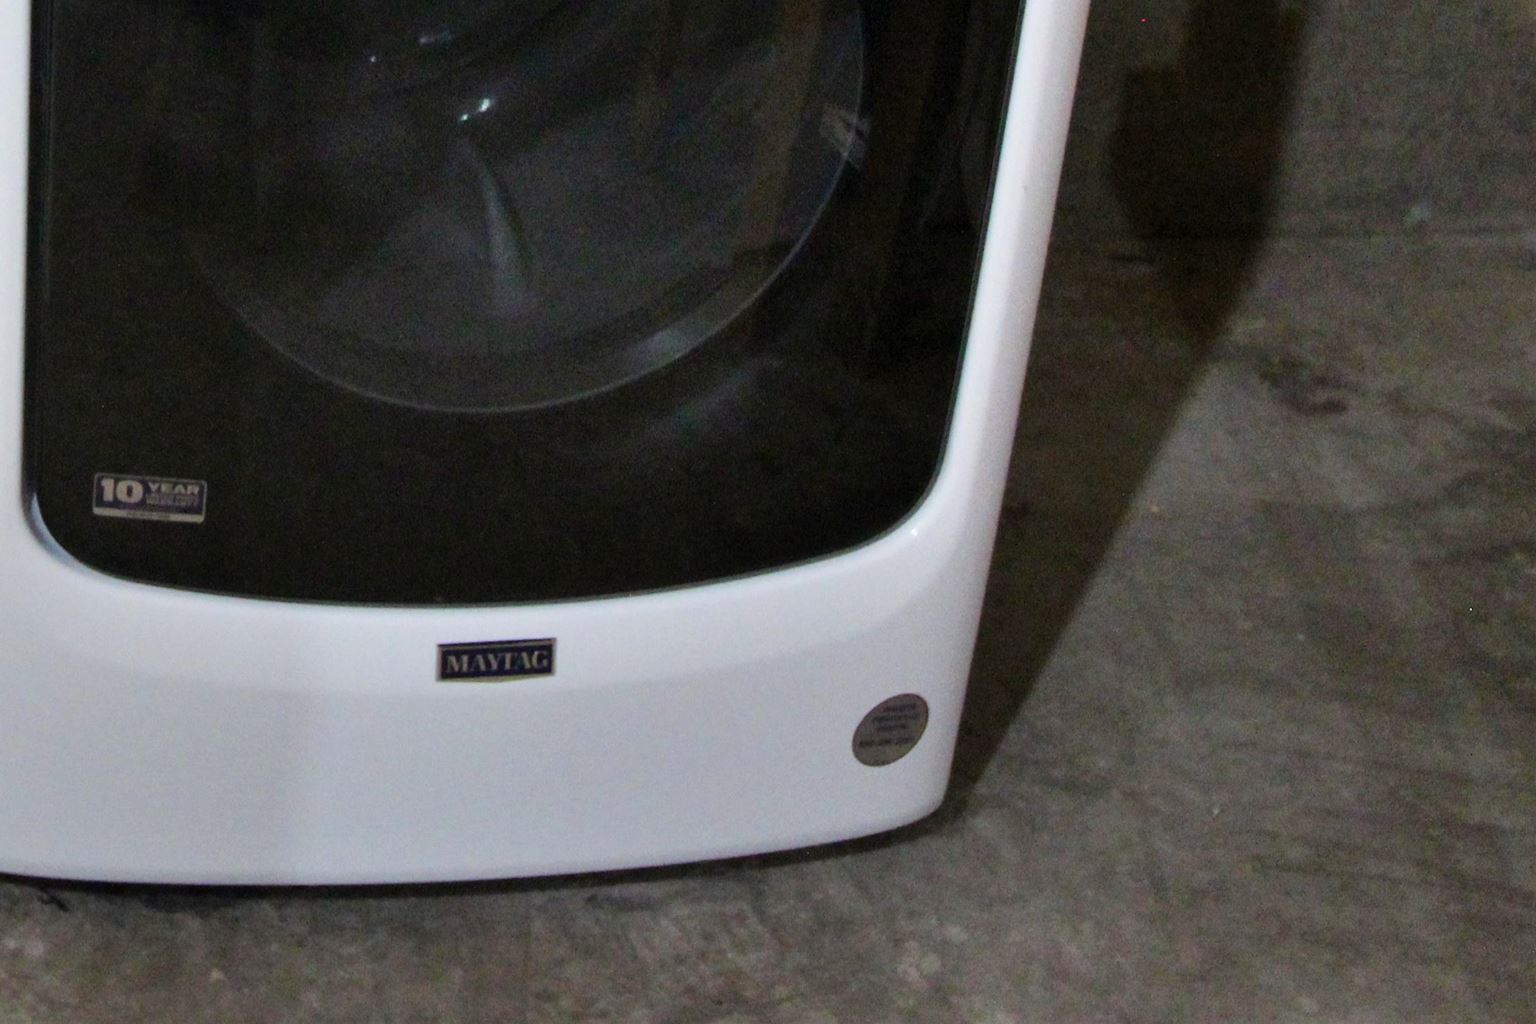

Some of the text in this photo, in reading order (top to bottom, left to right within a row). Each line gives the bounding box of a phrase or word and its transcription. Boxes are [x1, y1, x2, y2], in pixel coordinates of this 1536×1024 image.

[100, 478, 144, 504] 10
[146, 481, 200, 495] YEAR
[446, 650, 549, 673] MAYTAG
